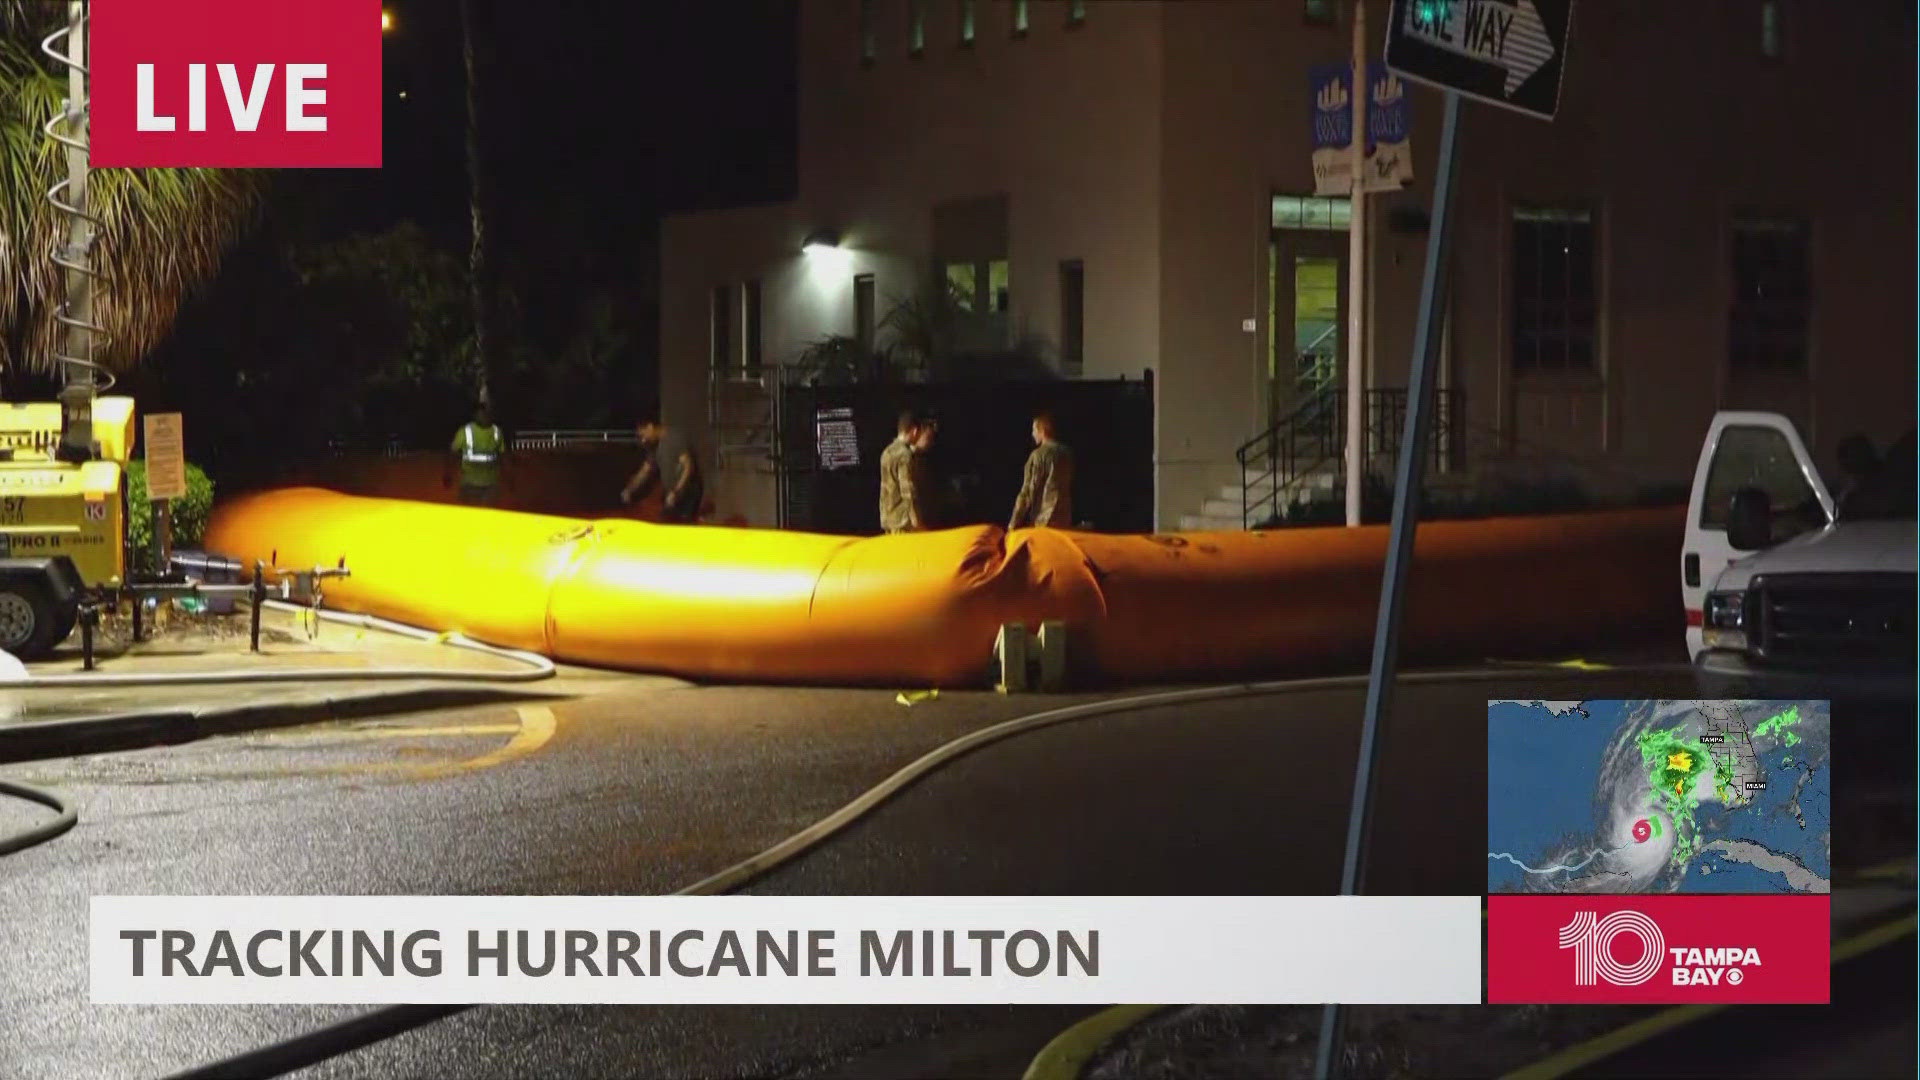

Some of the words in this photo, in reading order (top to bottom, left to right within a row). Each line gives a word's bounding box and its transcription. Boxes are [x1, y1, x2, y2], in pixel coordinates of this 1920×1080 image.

[1412, 0, 1453, 42] ONE
[1463, 0, 1516, 58] WAY
[12, 535, 47, 548] PRO
